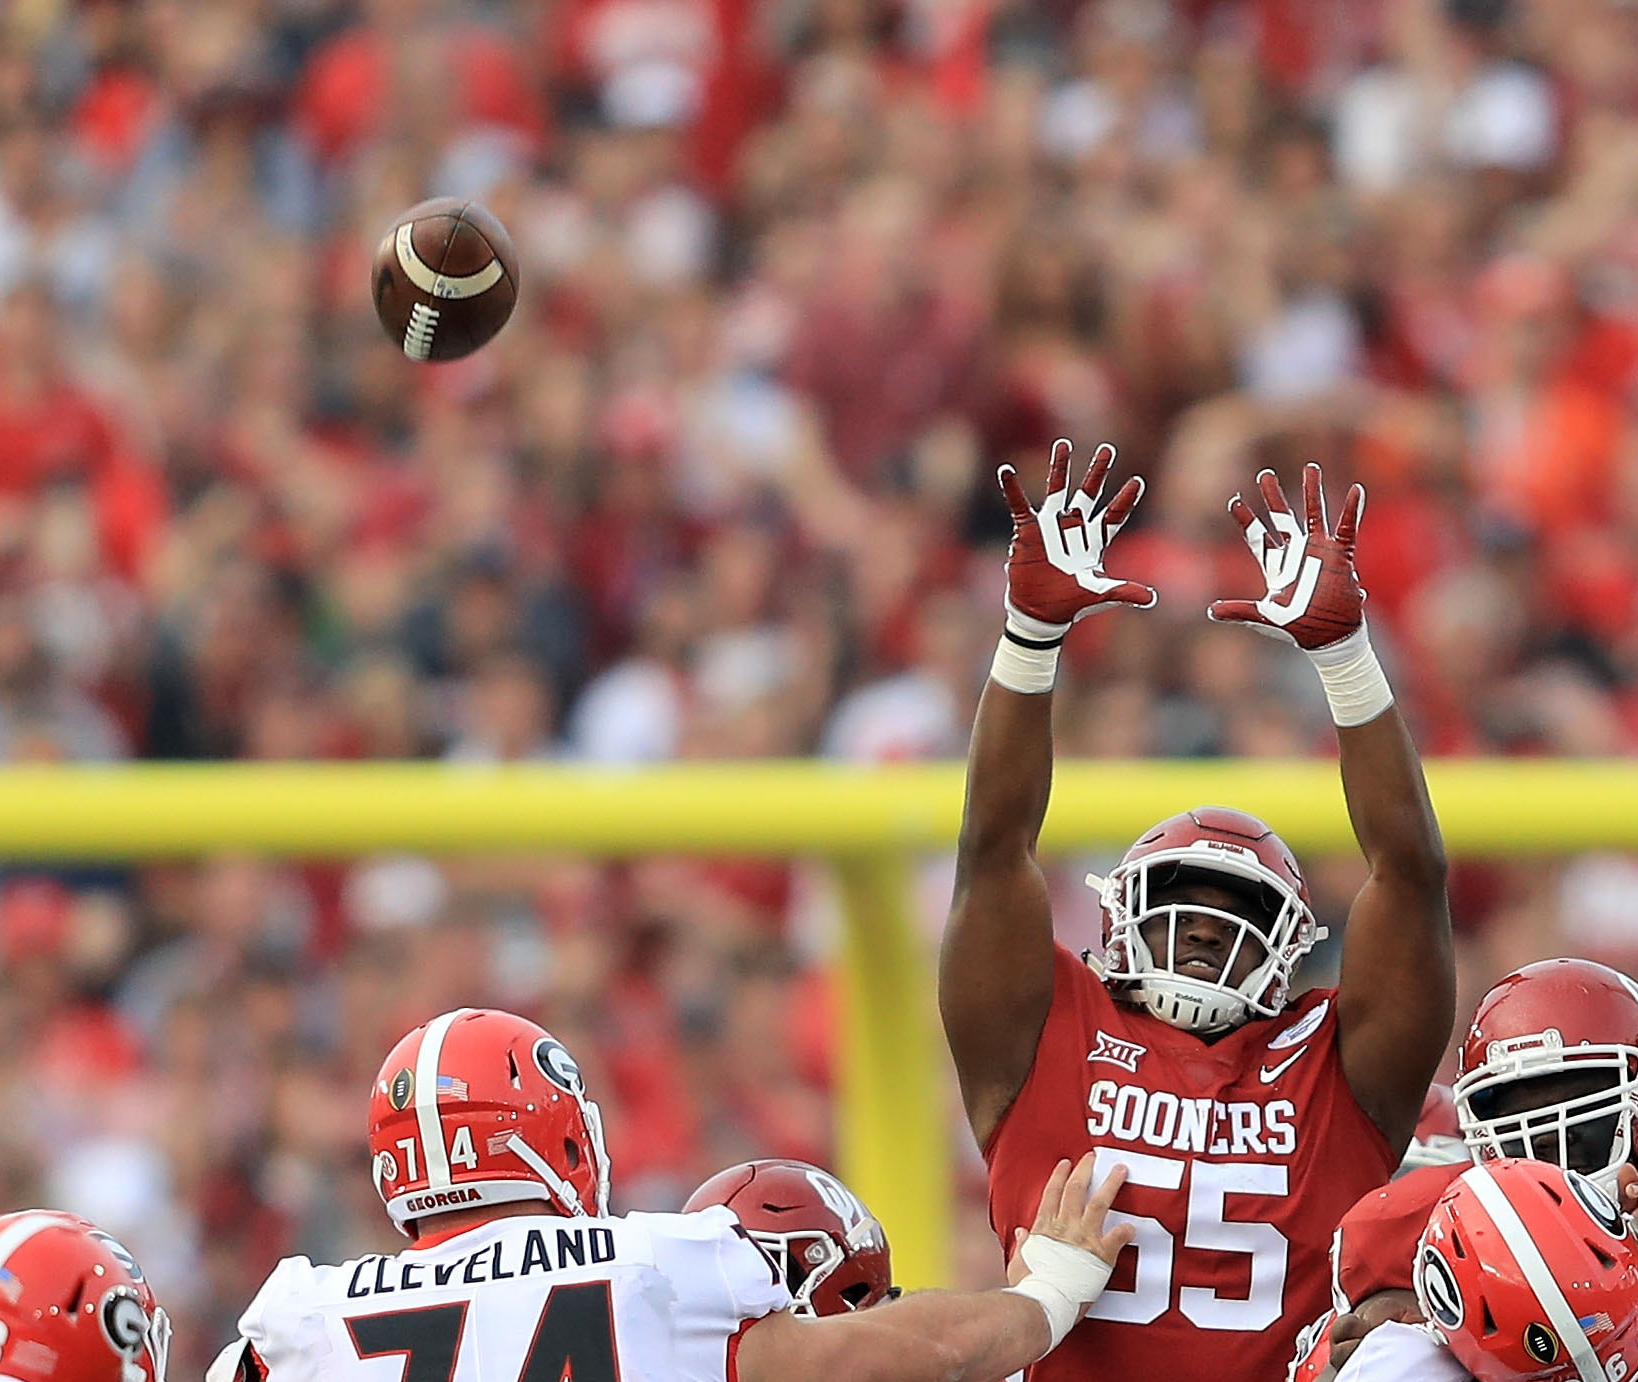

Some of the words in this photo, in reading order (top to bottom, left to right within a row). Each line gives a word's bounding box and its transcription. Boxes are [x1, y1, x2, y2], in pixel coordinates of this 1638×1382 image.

[1087, 1083, 1296, 1156] SOONERS
[406, 1188, 483, 1213] GEORGIA
[346, 1228, 617, 1299] CLEVELAND
[1084, 1147, 1289, 1332] 55
